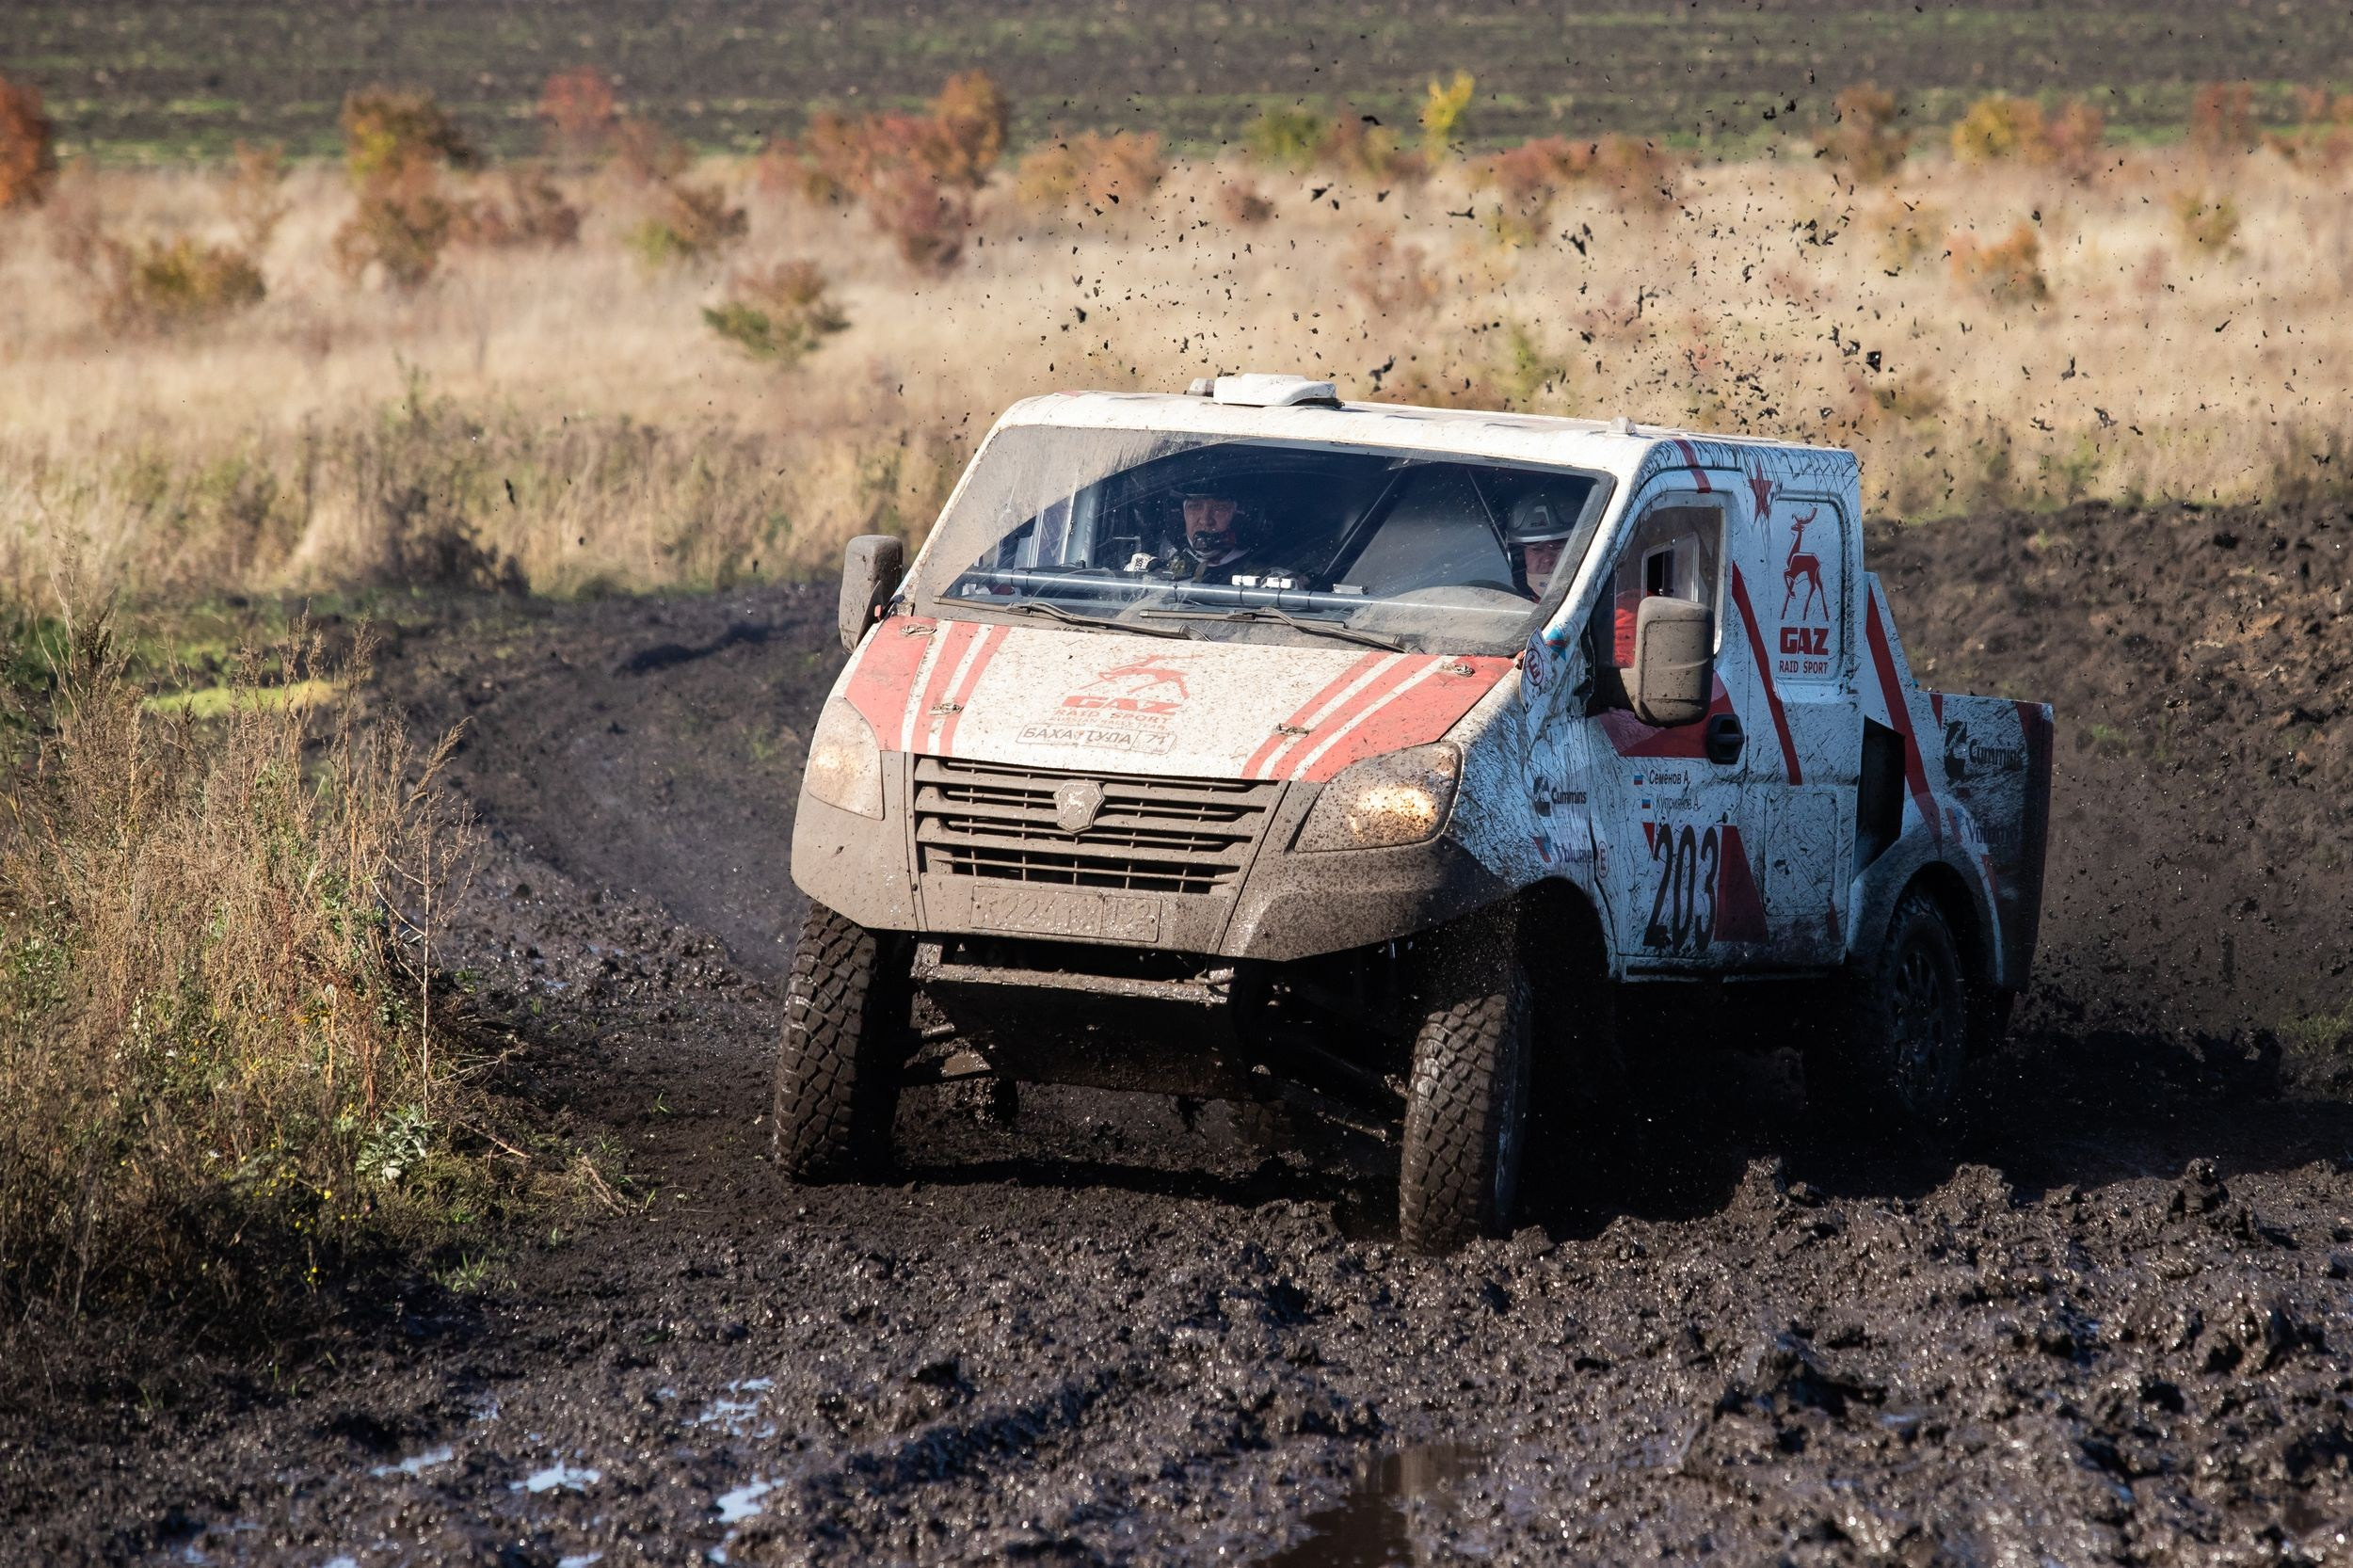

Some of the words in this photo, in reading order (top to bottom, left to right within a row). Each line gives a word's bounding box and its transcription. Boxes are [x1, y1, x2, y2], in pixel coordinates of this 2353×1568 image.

[1780, 627, 1829, 655] GAZ
[1779, 660, 1799, 674] RAID
[1803, 661, 1829, 675] SPORT
[1062, 696, 1183, 715] GAZ
[1110, 712, 1170, 724] SPORT
[1022, 728, 1073, 740] БАХА
[1968, 739, 2025, 770] Cummin
[1551, 787, 1587, 805] Cummins
[1642, 824, 1720, 954] 203
